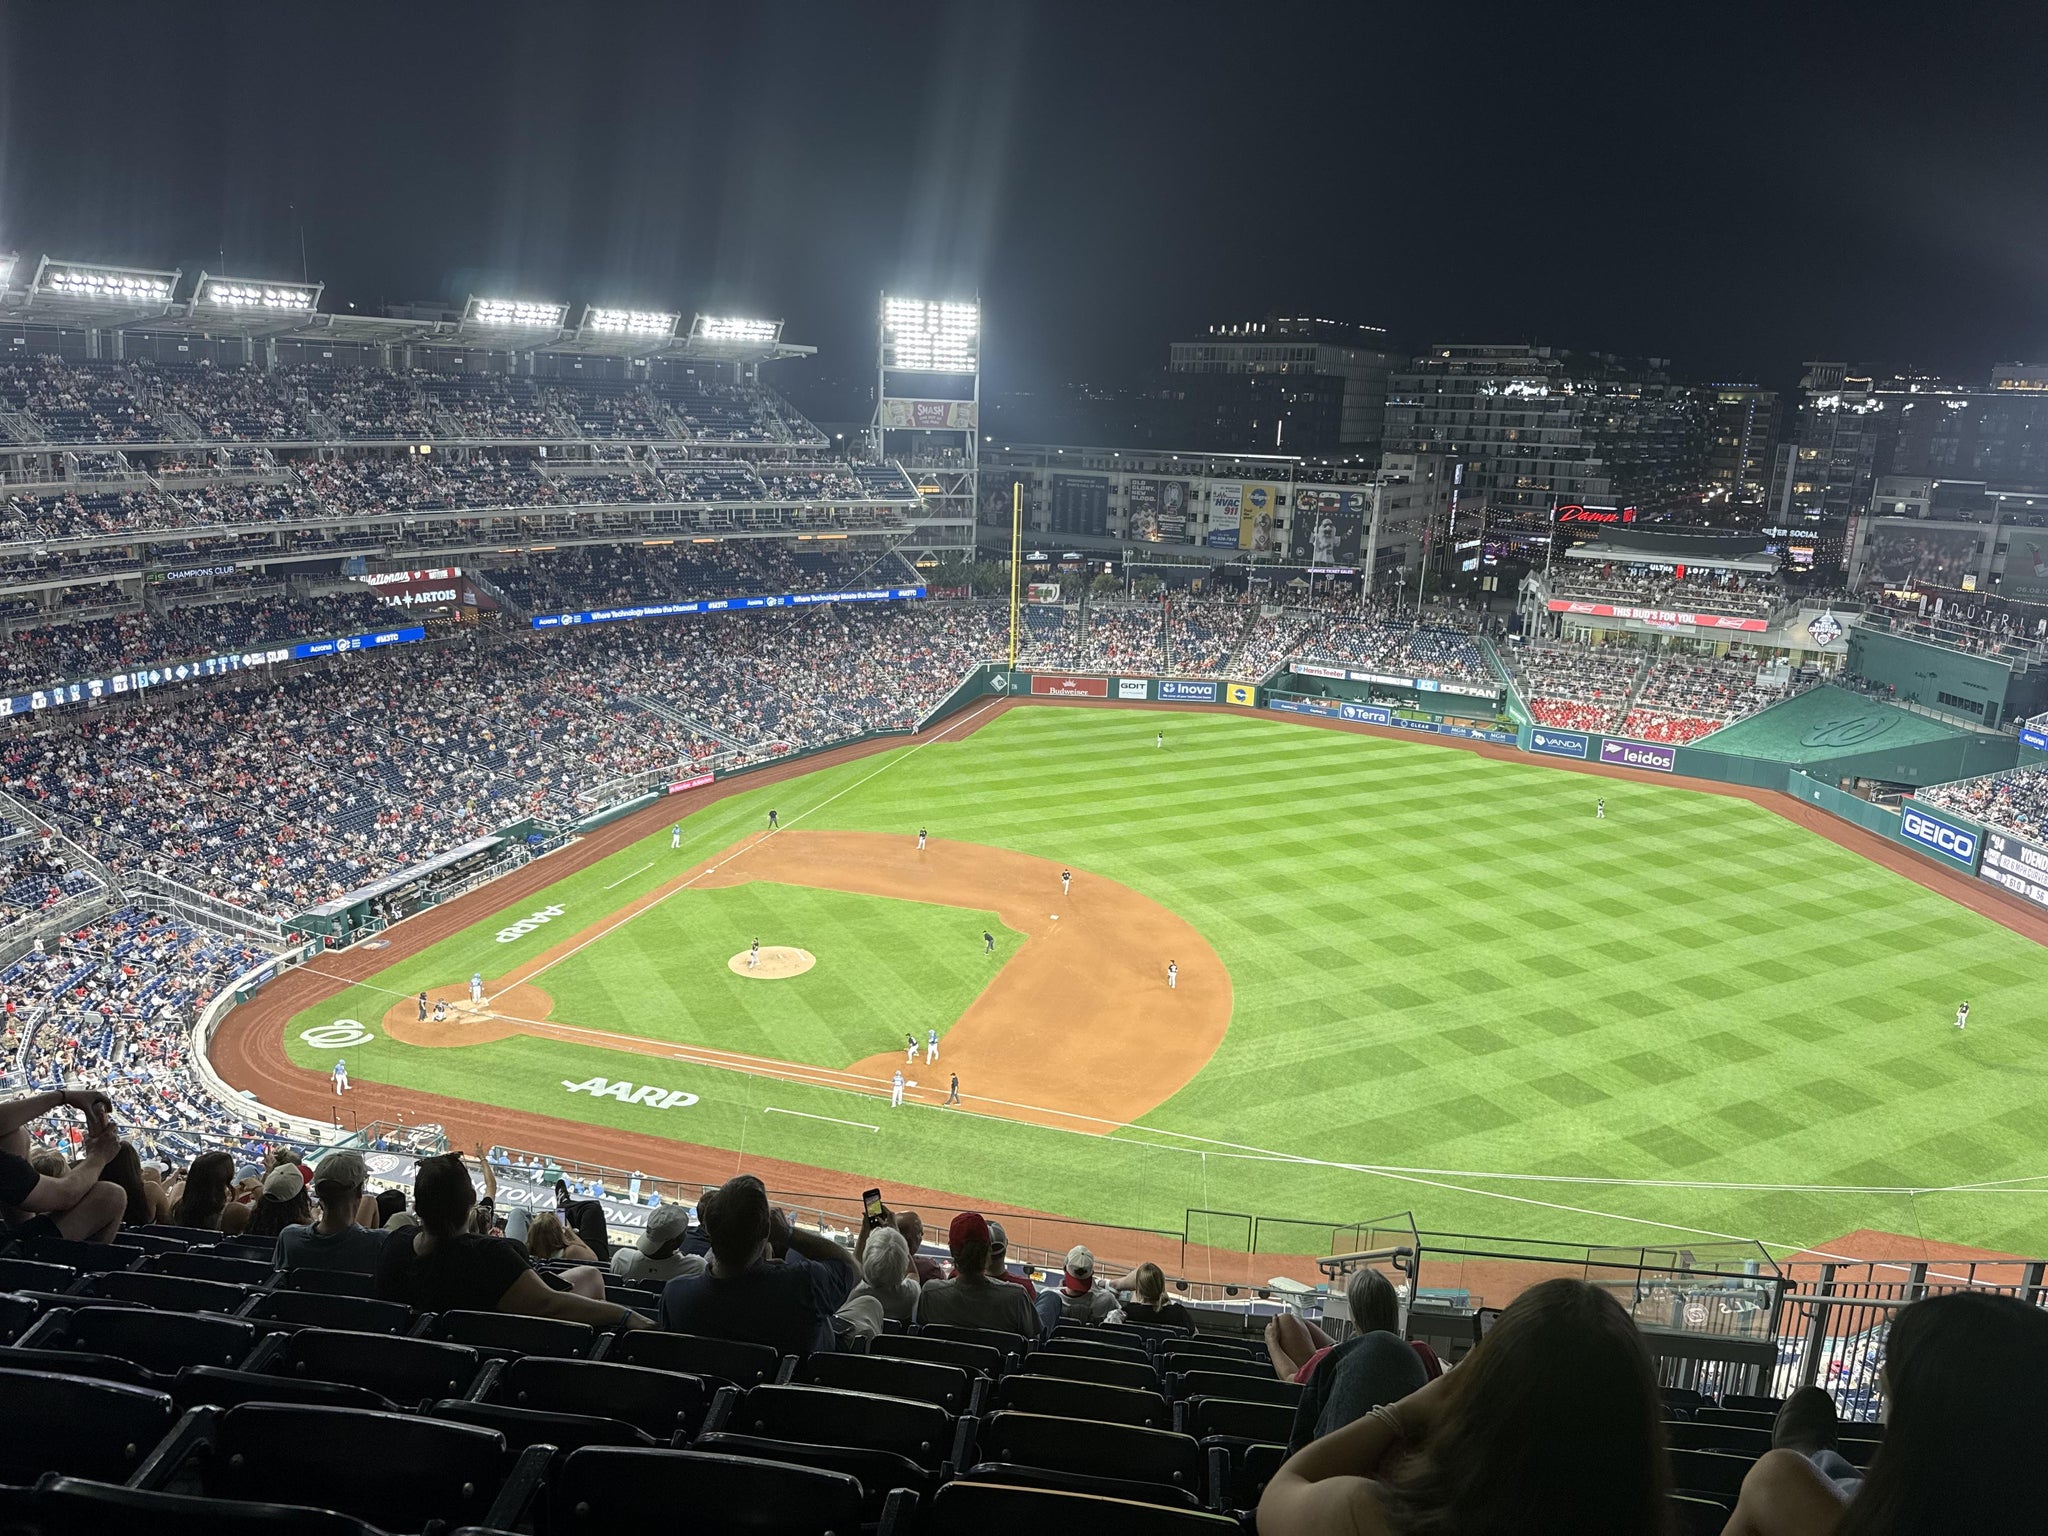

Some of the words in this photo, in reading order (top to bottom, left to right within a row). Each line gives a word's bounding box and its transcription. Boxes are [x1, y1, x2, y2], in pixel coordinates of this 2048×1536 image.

[917, 404, 944, 416] SMASH
[1215, 499, 1240, 507] HVAC
[1224, 507, 1238, 516] 911
[1789, 529, 1819, 539] SOCIAL
[1846, 527, 1855, 546] TEAM
[167, 568, 213, 580] CHAMPIONS
[215, 566, 234, 575] CLUB
[1686, 567, 1709, 576] LOFT
[414, 590, 456, 604] ARTOIS
[672, 604, 698, 612] Diamond
[1612, 607, 1631, 617] THIS
[1632, 608, 1657, 620] BUD'S
[1659, 611, 1677, 622] FOR
[1678, 613, 1696, 624] YOU.
[1323, 669, 1343, 677] Teeter
[1050, 687, 1088, 695] Budweiser
[1178, 683, 1212, 695] Inova
[1469, 688, 1496, 698] FAN
[1356, 709, 1385, 722] Terra
[1546, 737, 1582, 749] VANDA
[1624, 748, 1670, 767] leidos
[1904, 813, 1974, 857] GEICO
[2020, 846, 2048, 873] YOEND
[495, 903, 566, 943] AARP
[560, 1077, 700, 1109] AARP
